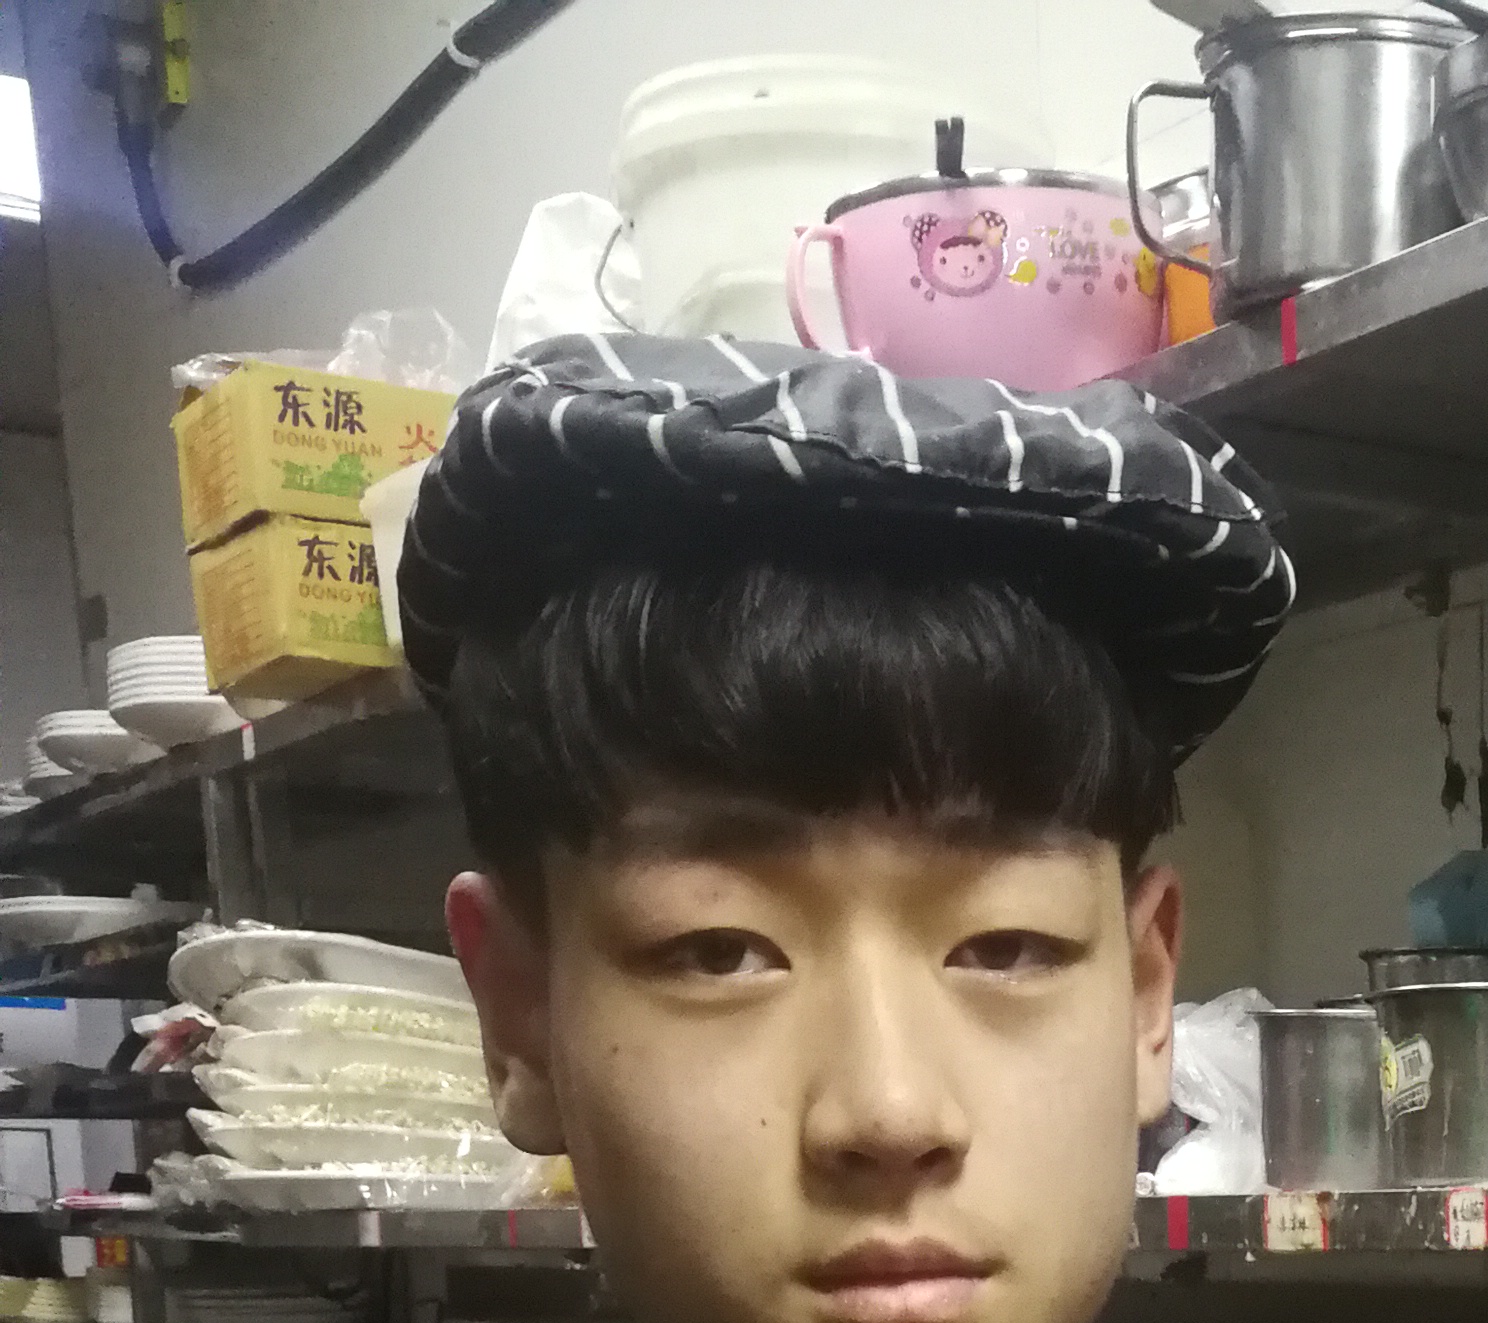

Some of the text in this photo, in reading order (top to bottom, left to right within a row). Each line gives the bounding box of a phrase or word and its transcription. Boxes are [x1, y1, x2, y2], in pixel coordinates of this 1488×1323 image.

[273, 380, 367, 435] 东源
[273, 428, 383, 458] DONG YUAN
[398, 423, 438, 453] 火
[299, 582, 352, 603] DONG
